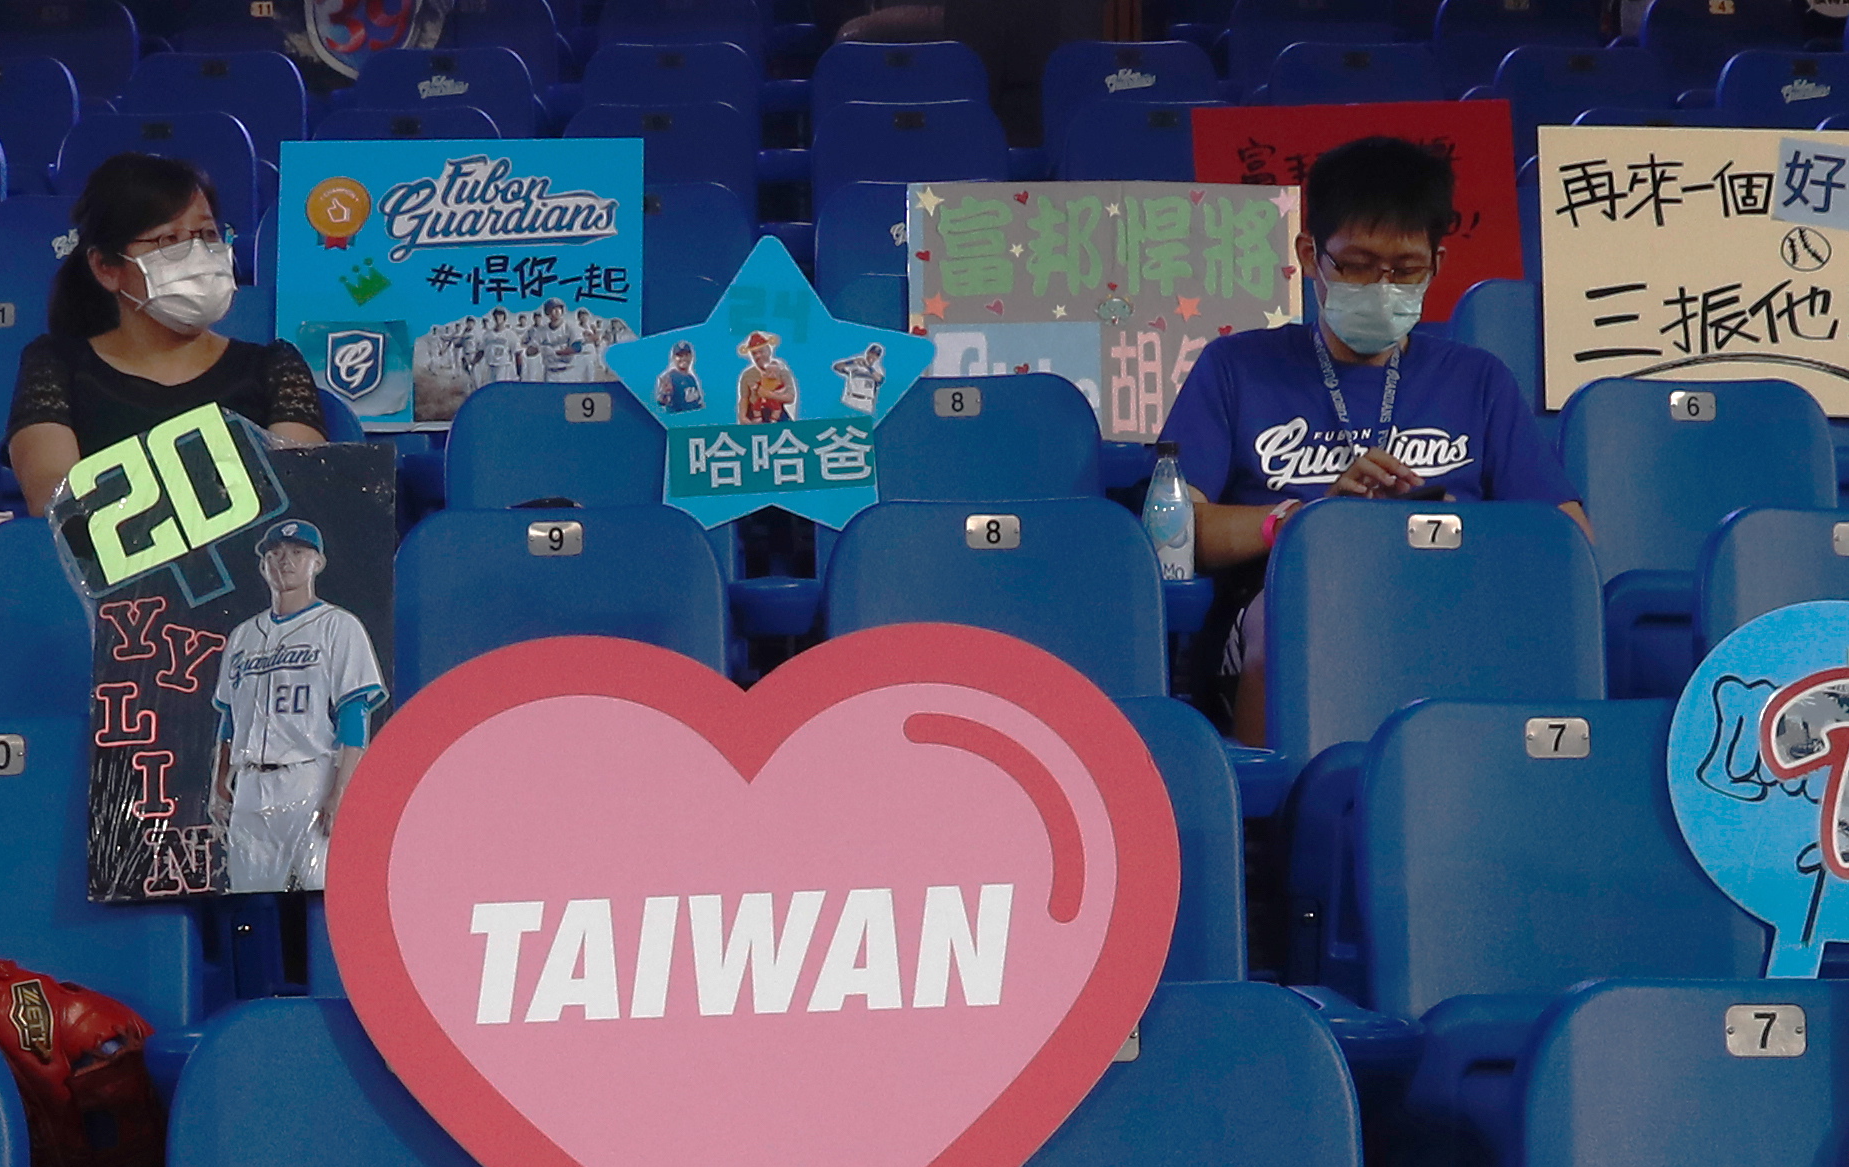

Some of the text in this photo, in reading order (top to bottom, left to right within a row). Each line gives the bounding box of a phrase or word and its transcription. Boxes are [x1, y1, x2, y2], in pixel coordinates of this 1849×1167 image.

[440, 155, 552, 207] Fubon
[378, 178, 619, 263] Guardians
[937, 195, 1280, 298] 富邦悍將
[426, 255, 630, 304] #悍你一起
[1574, 281, 1839, 362] 三振他
[582, 397, 594, 418] 9
[952, 391, 964, 413] 8
[1687, 396, 1700, 417] 6
[688, 425, 873, 488] 哈哈爸
[69, 402, 261, 585] 20
[549, 527, 564, 552] 9
[986, 520, 1001, 544] 8
[1427, 521, 1441, 545] 7
[275, 684, 311, 714] 20
[1550, 724, 1566, 752] 7
[469, 883, 1014, 1024] TAIWAN
[1753, 1011, 1778, 1049] 7
